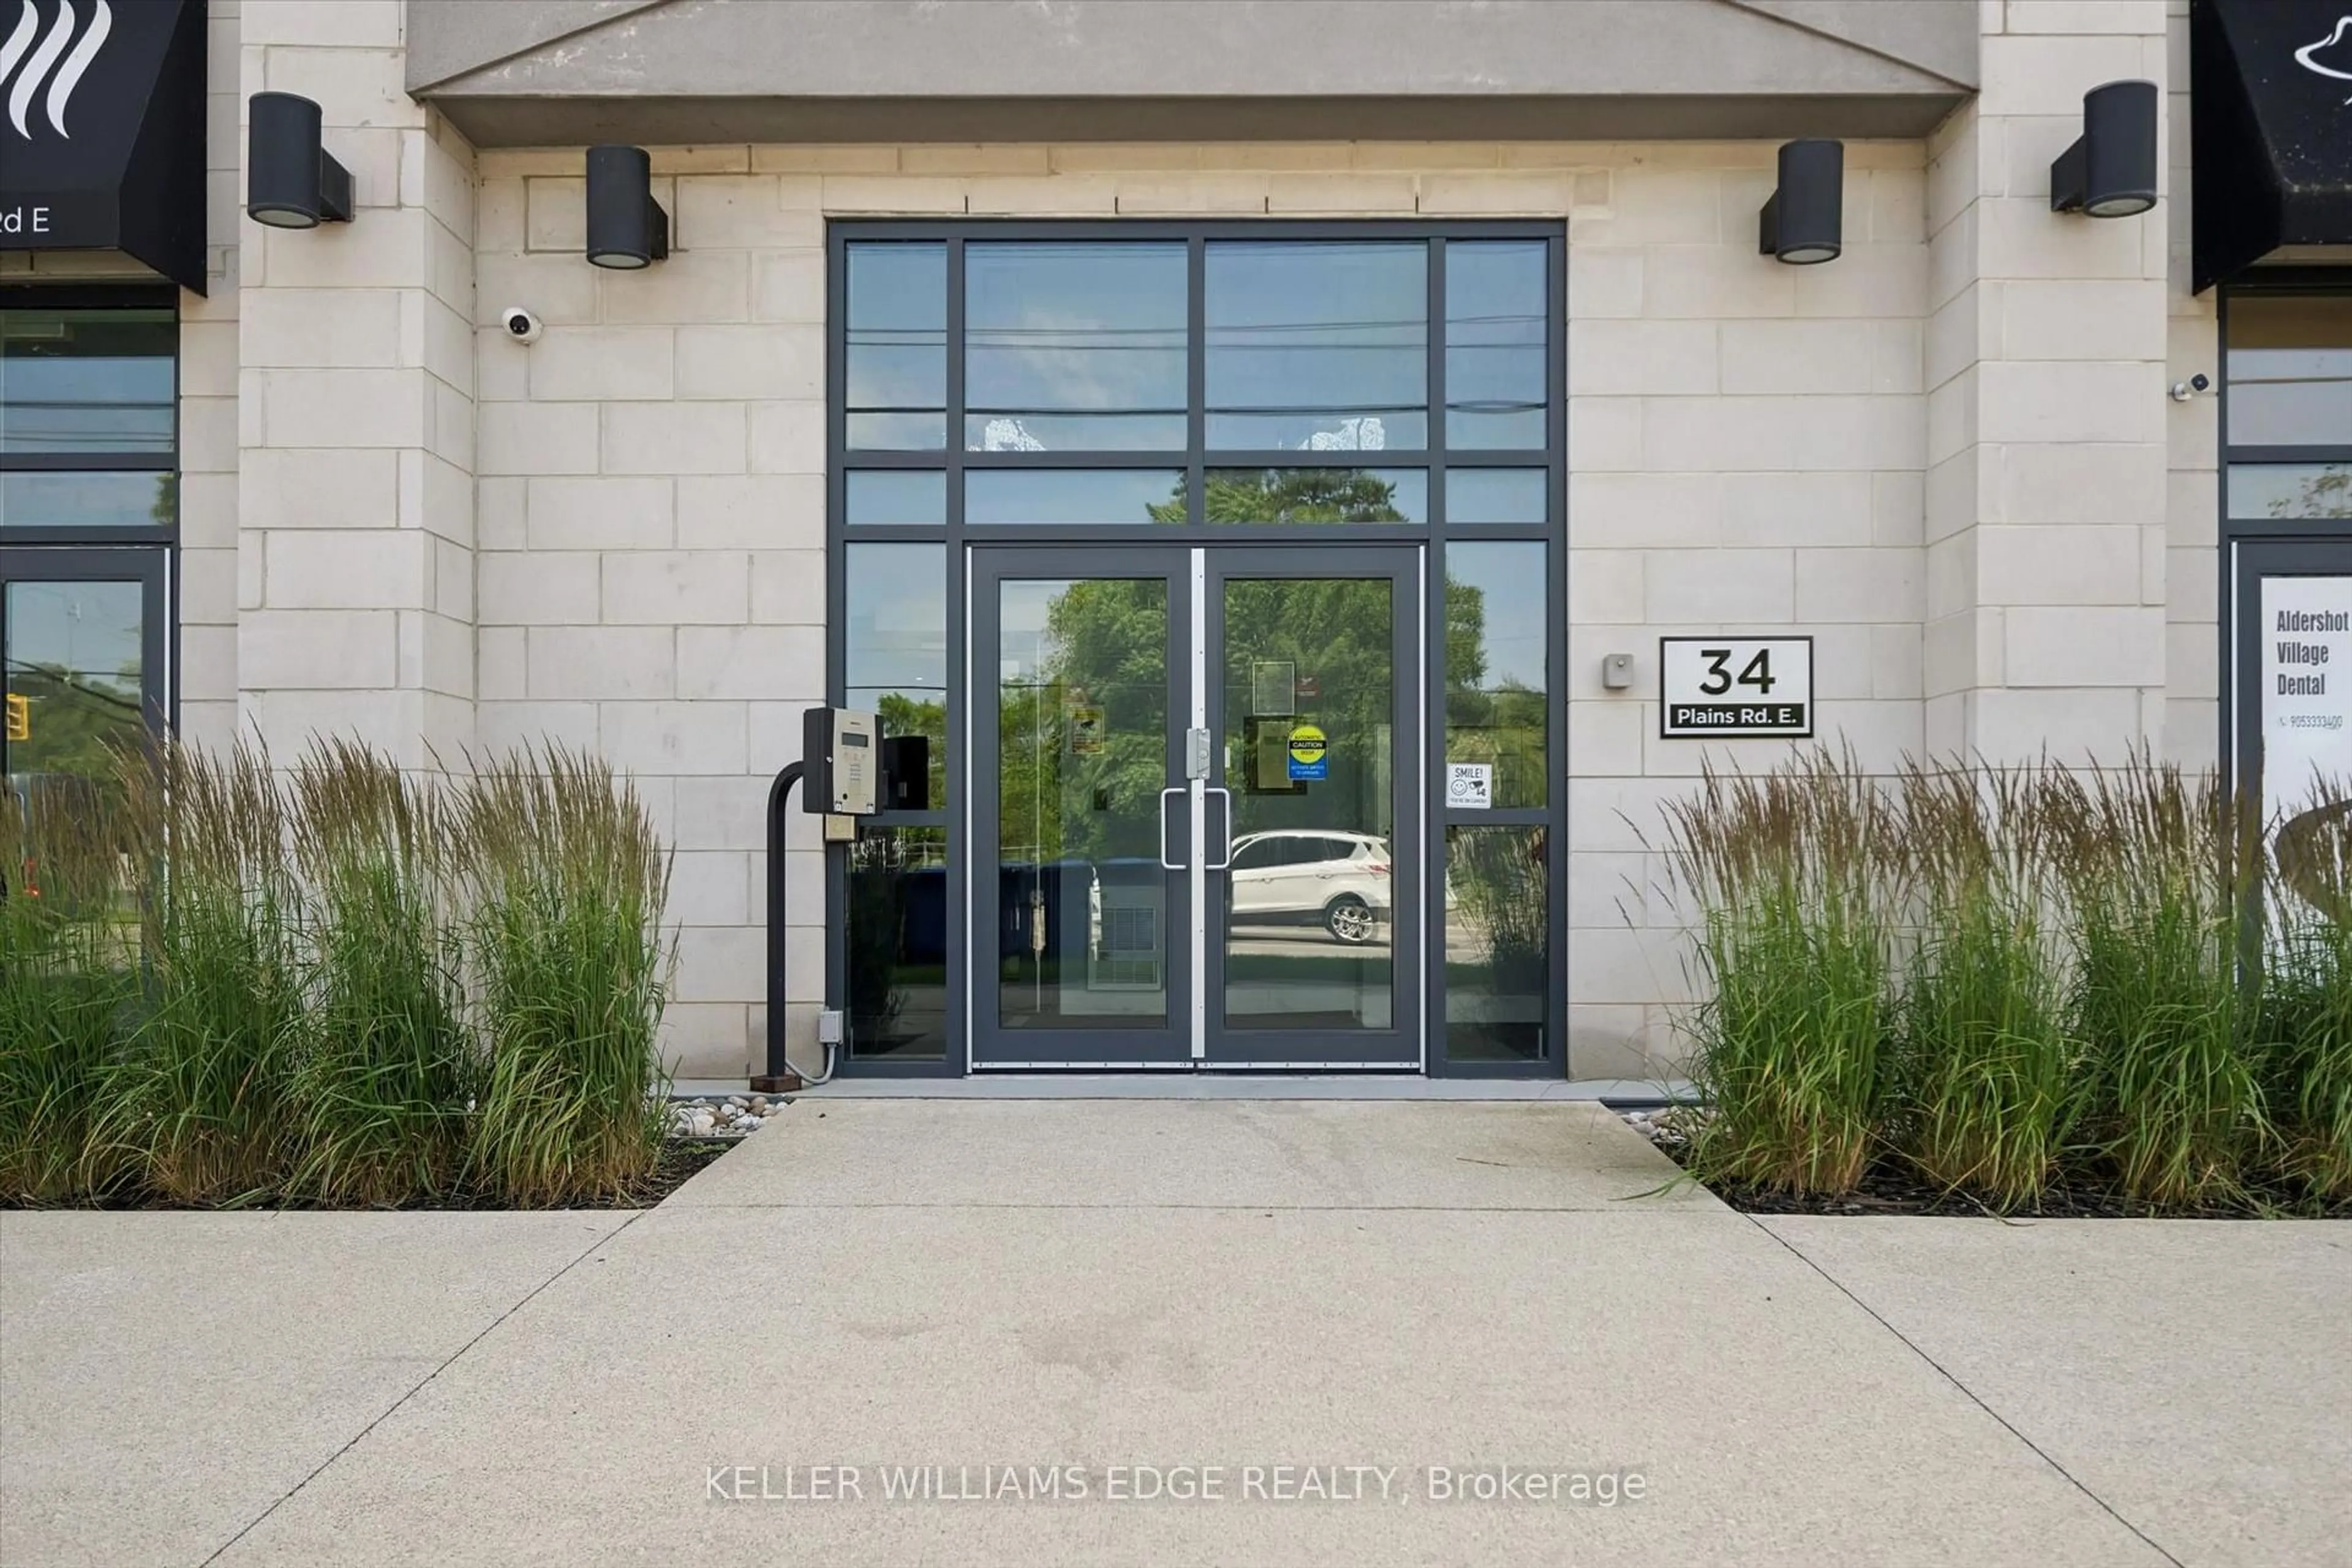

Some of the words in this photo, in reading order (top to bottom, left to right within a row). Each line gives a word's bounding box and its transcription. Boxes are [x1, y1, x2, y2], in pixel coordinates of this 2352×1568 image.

[0, 206, 22, 233] d
[33, 207, 50, 232] E
[2277, 610, 2350, 631] Aldershot
[2277, 642, 2329, 666] Village
[1699, 648, 1776, 695] 34
[2277, 674, 2326, 695] Dental
[1677, 708, 1735, 725] Plains
[1740, 708, 1773, 725] Rd.
[1778, 709, 1796, 724] E.
[1455, 767, 1483, 778] SMILE!
